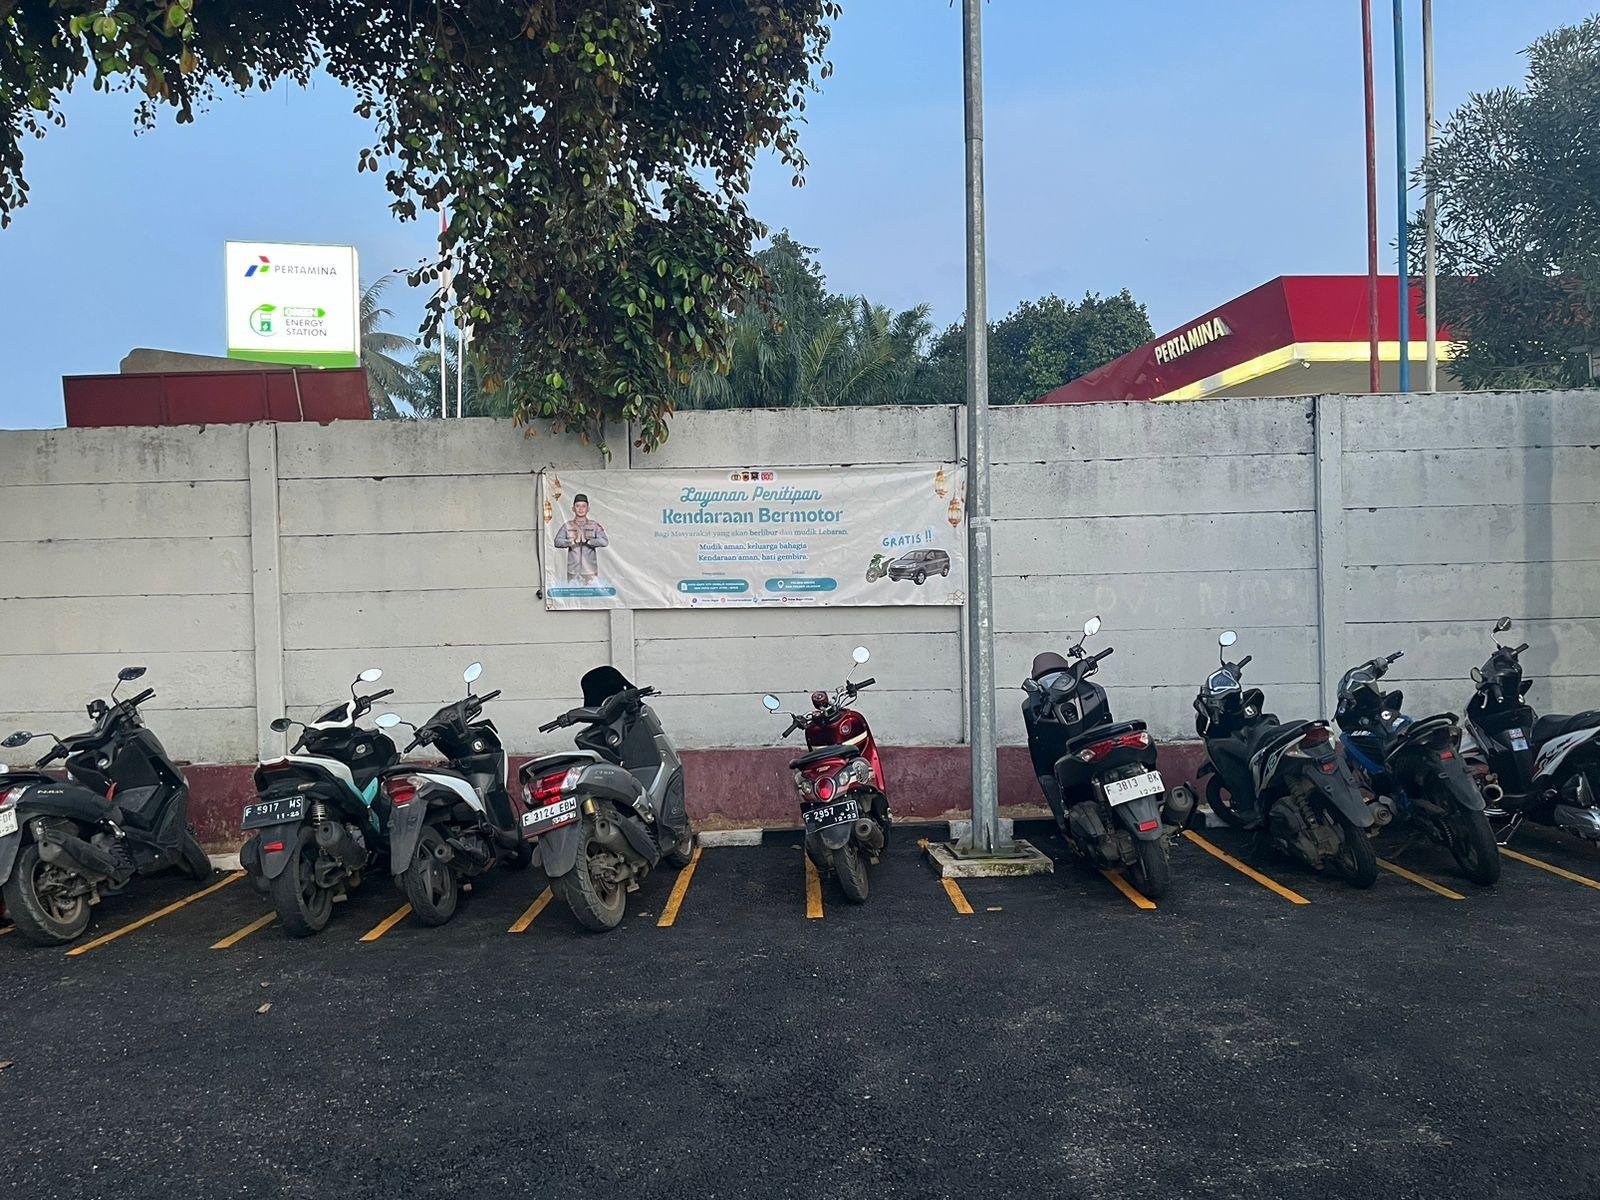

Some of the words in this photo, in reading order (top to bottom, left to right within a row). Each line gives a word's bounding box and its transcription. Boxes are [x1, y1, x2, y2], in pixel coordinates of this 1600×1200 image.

[274, 265, 337, 276] PERTAMINA
[285, 319, 324, 327] ENERGY
[286, 328, 327, 337] STATION
[1154, 316, 1228, 365] PERTAMINA
[680, 486, 749, 508] Layanan
[752, 486, 822, 505] Penitipan
[662, 508, 754, 524] Kendaraan
[758, 507, 843, 523] Bermotor
[731, 529, 748, 537] akan
[749, 529, 778, 537] berlibur
[794, 528, 817, 536] mudik
[882, 534, 922, 547] GRATIS
[925, 530, 932, 542] !!
[699, 543, 723, 551] Mudik
[746, 542, 778, 551] keluarga
[779, 542, 807, 551] bahagia
[698, 554, 737, 562] Kendaraan
[761, 553, 776, 561] hati
[777, 553, 808, 562] gembira.
[1105, 785, 1112, 796] F
[1116, 778, 1139, 792] 3813
[1146, 772, 1160, 783] BK
[245, 807, 252, 817] F
[256, 802, 280, 815] 5917
[289, 799, 301, 809] MS
[523, 815, 530, 826] F
[533, 807, 555, 822] 3124
[559, 799, 576, 813] EBM
[804, 813, 810, 823] F
[813, 806, 834, 820] 2957
[845, 802, 855, 812] JT
